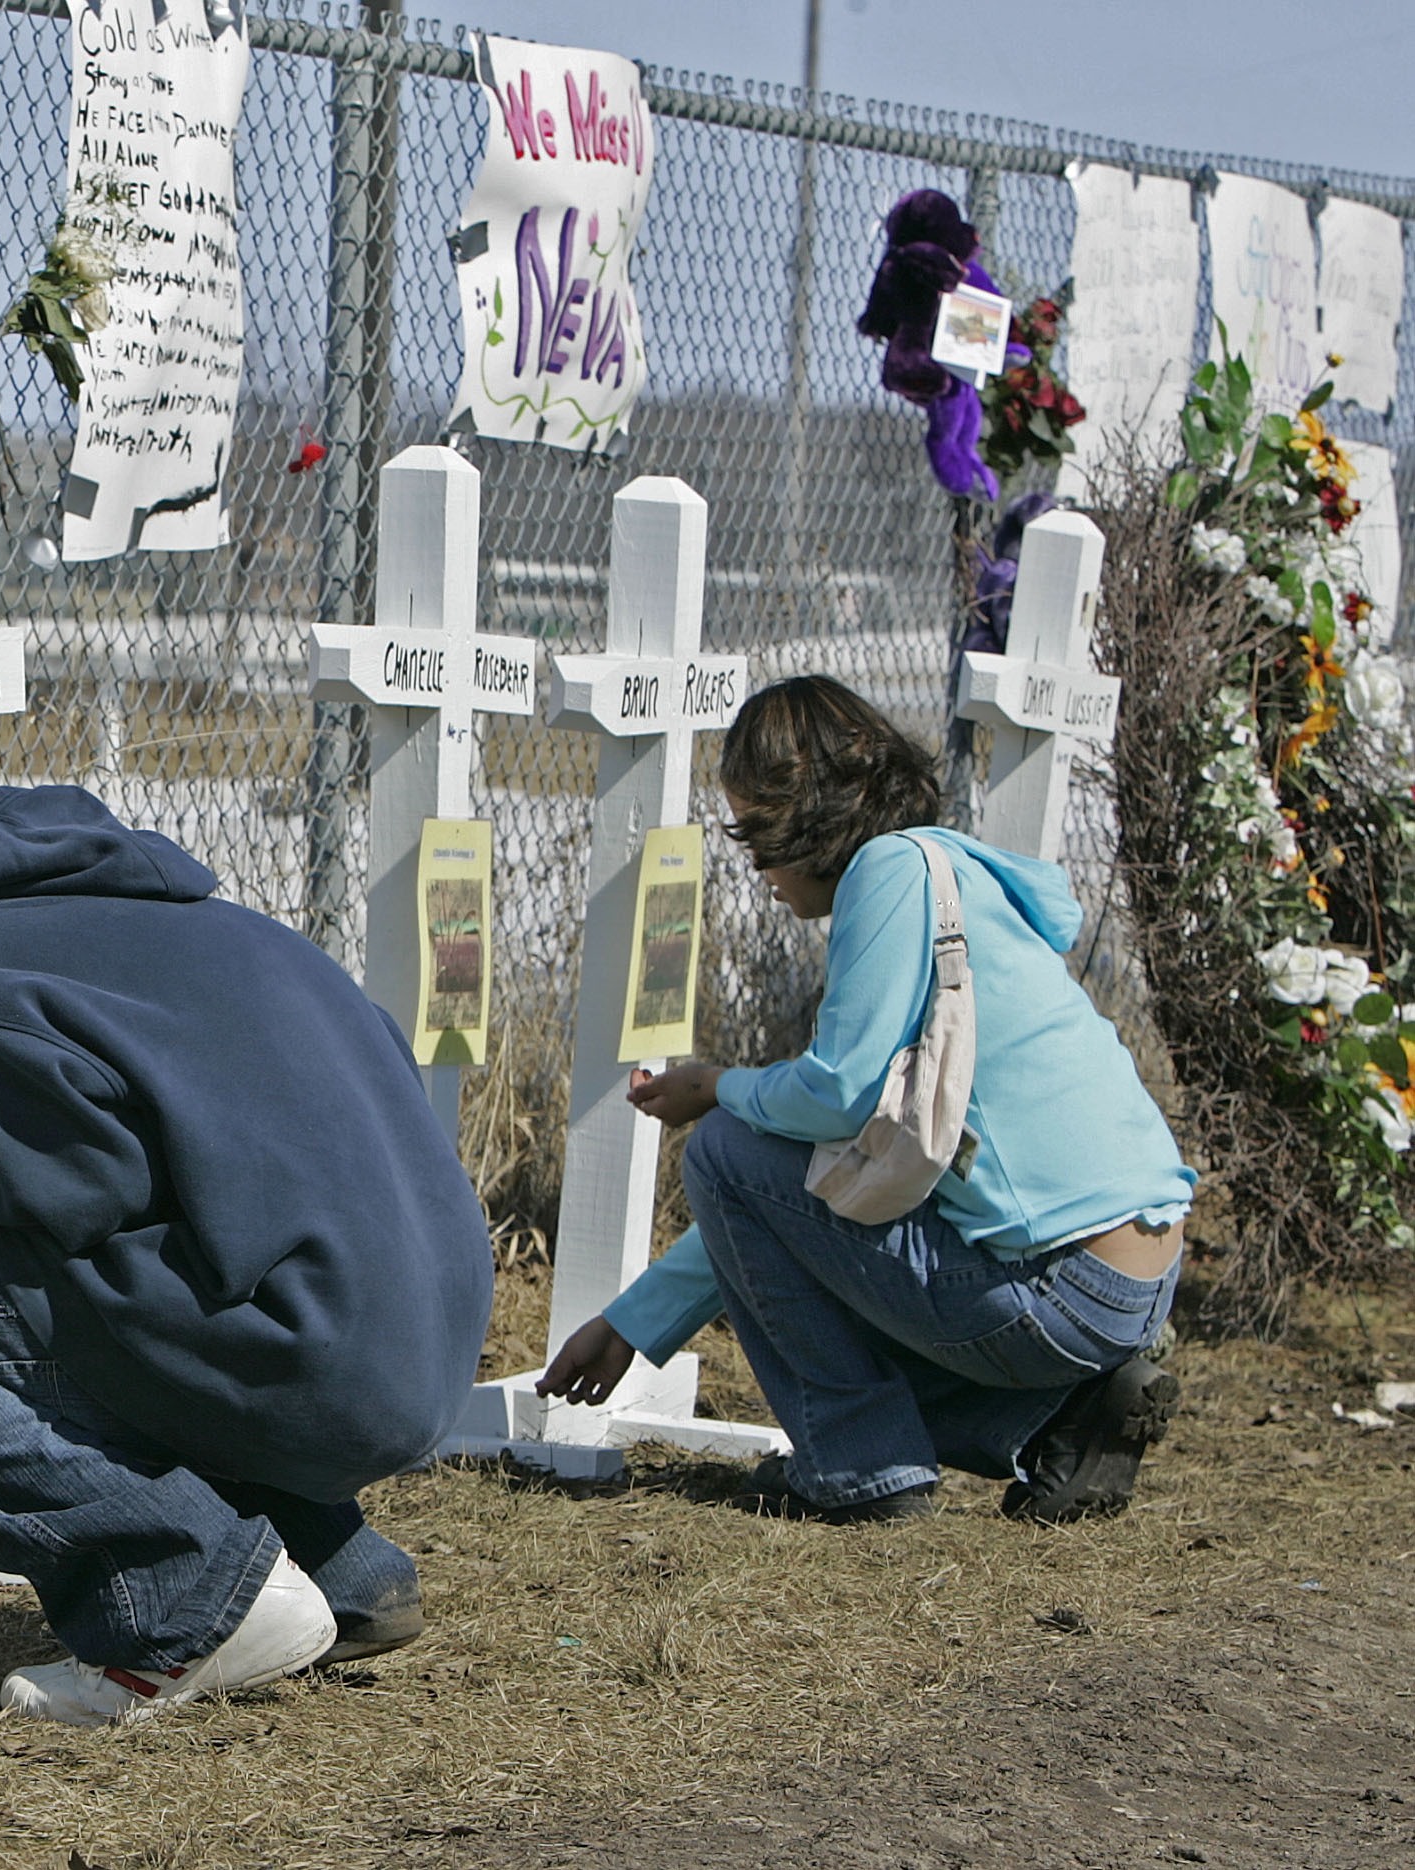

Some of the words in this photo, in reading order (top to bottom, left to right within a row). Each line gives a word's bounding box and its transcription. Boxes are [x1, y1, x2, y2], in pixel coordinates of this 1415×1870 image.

[80, 7, 136, 56] Cold
[146, 28, 164, 53] as
[493, 70, 557, 161] We
[564, 70, 628, 167] Miss
[513, 206, 626, 389] NEVA
[384, 641, 444, 693] CHANELLE
[473, 646, 529, 706] ROSEBEAR
[682, 662, 736, 724] ROGERS
